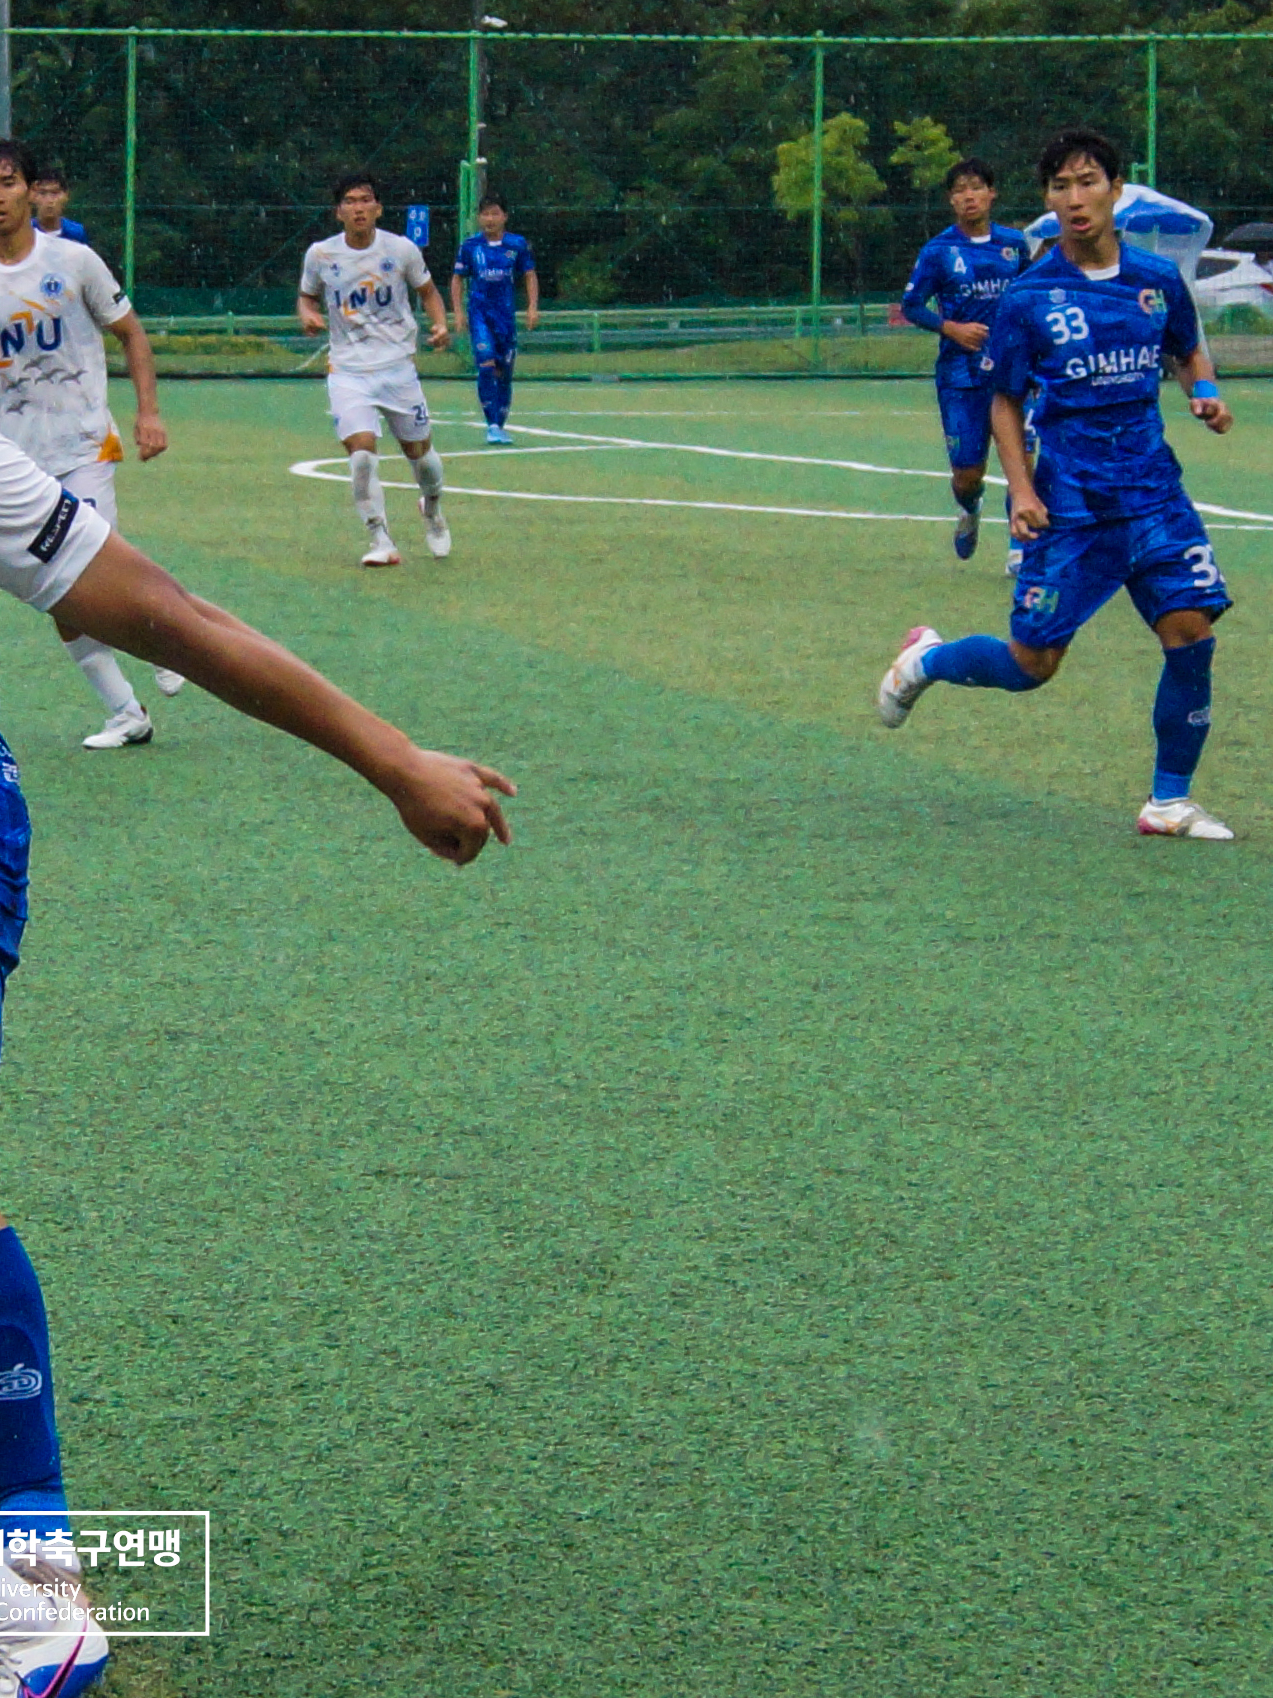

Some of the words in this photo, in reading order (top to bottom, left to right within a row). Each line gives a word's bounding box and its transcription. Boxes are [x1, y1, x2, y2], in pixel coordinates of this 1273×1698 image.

[334, 284, 392, 309] INU
[1045, 306, 1090, 345] 33
[1065, 344, 1161, 379] GIMHAE
[1184, 544, 1226, 587] 3
